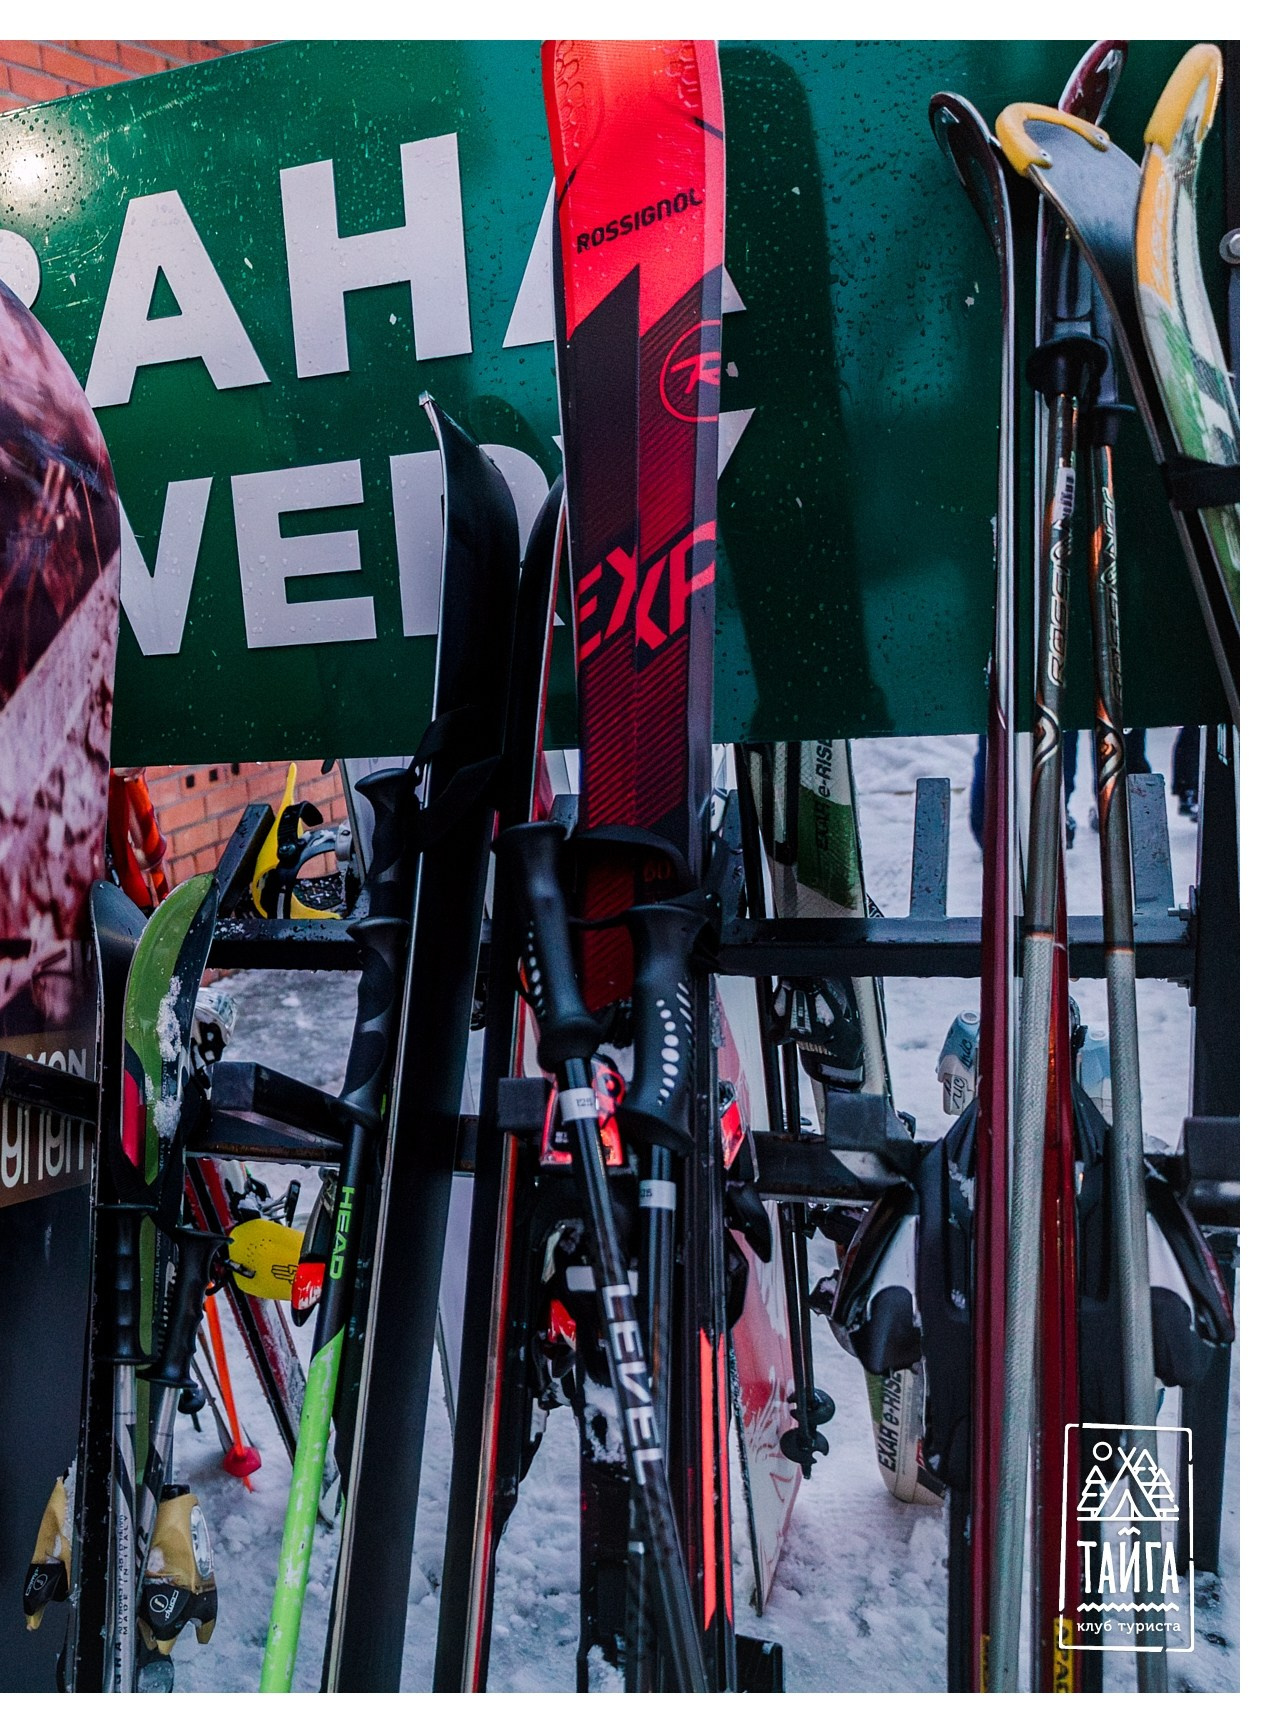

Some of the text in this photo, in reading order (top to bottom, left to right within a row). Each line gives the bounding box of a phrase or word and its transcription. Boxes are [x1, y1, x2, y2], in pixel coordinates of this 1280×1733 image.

[575, 186, 706, 256] ROSSIGNOL
[328, 1185, 356, 1281] HEAD
[601, 1284, 663, 1486] LEVEL
[877, 1422, 899, 1473] EXAR
